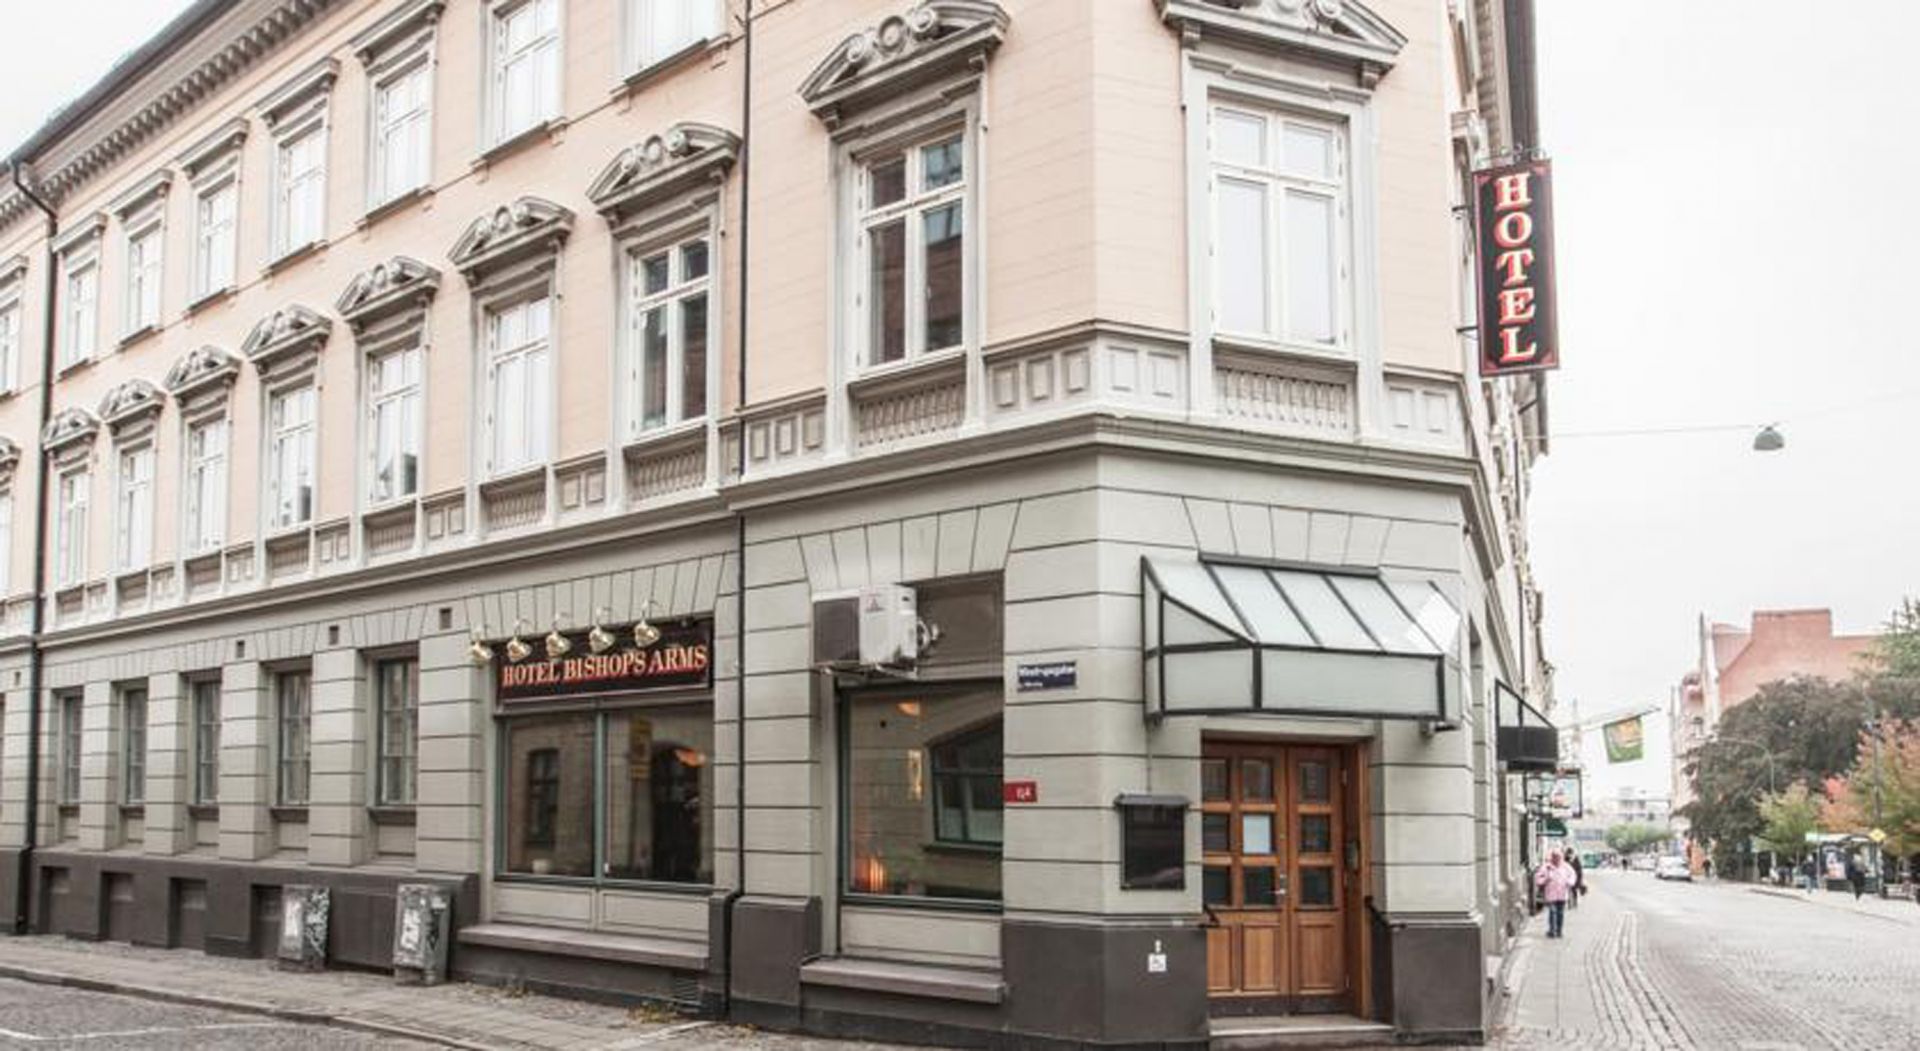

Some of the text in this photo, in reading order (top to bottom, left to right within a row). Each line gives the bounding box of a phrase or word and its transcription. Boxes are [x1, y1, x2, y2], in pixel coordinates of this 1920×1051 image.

[1494, 172, 1537, 363] HOTEL
[503, 644, 708, 687] HOTEL BISHOPS ARMS
